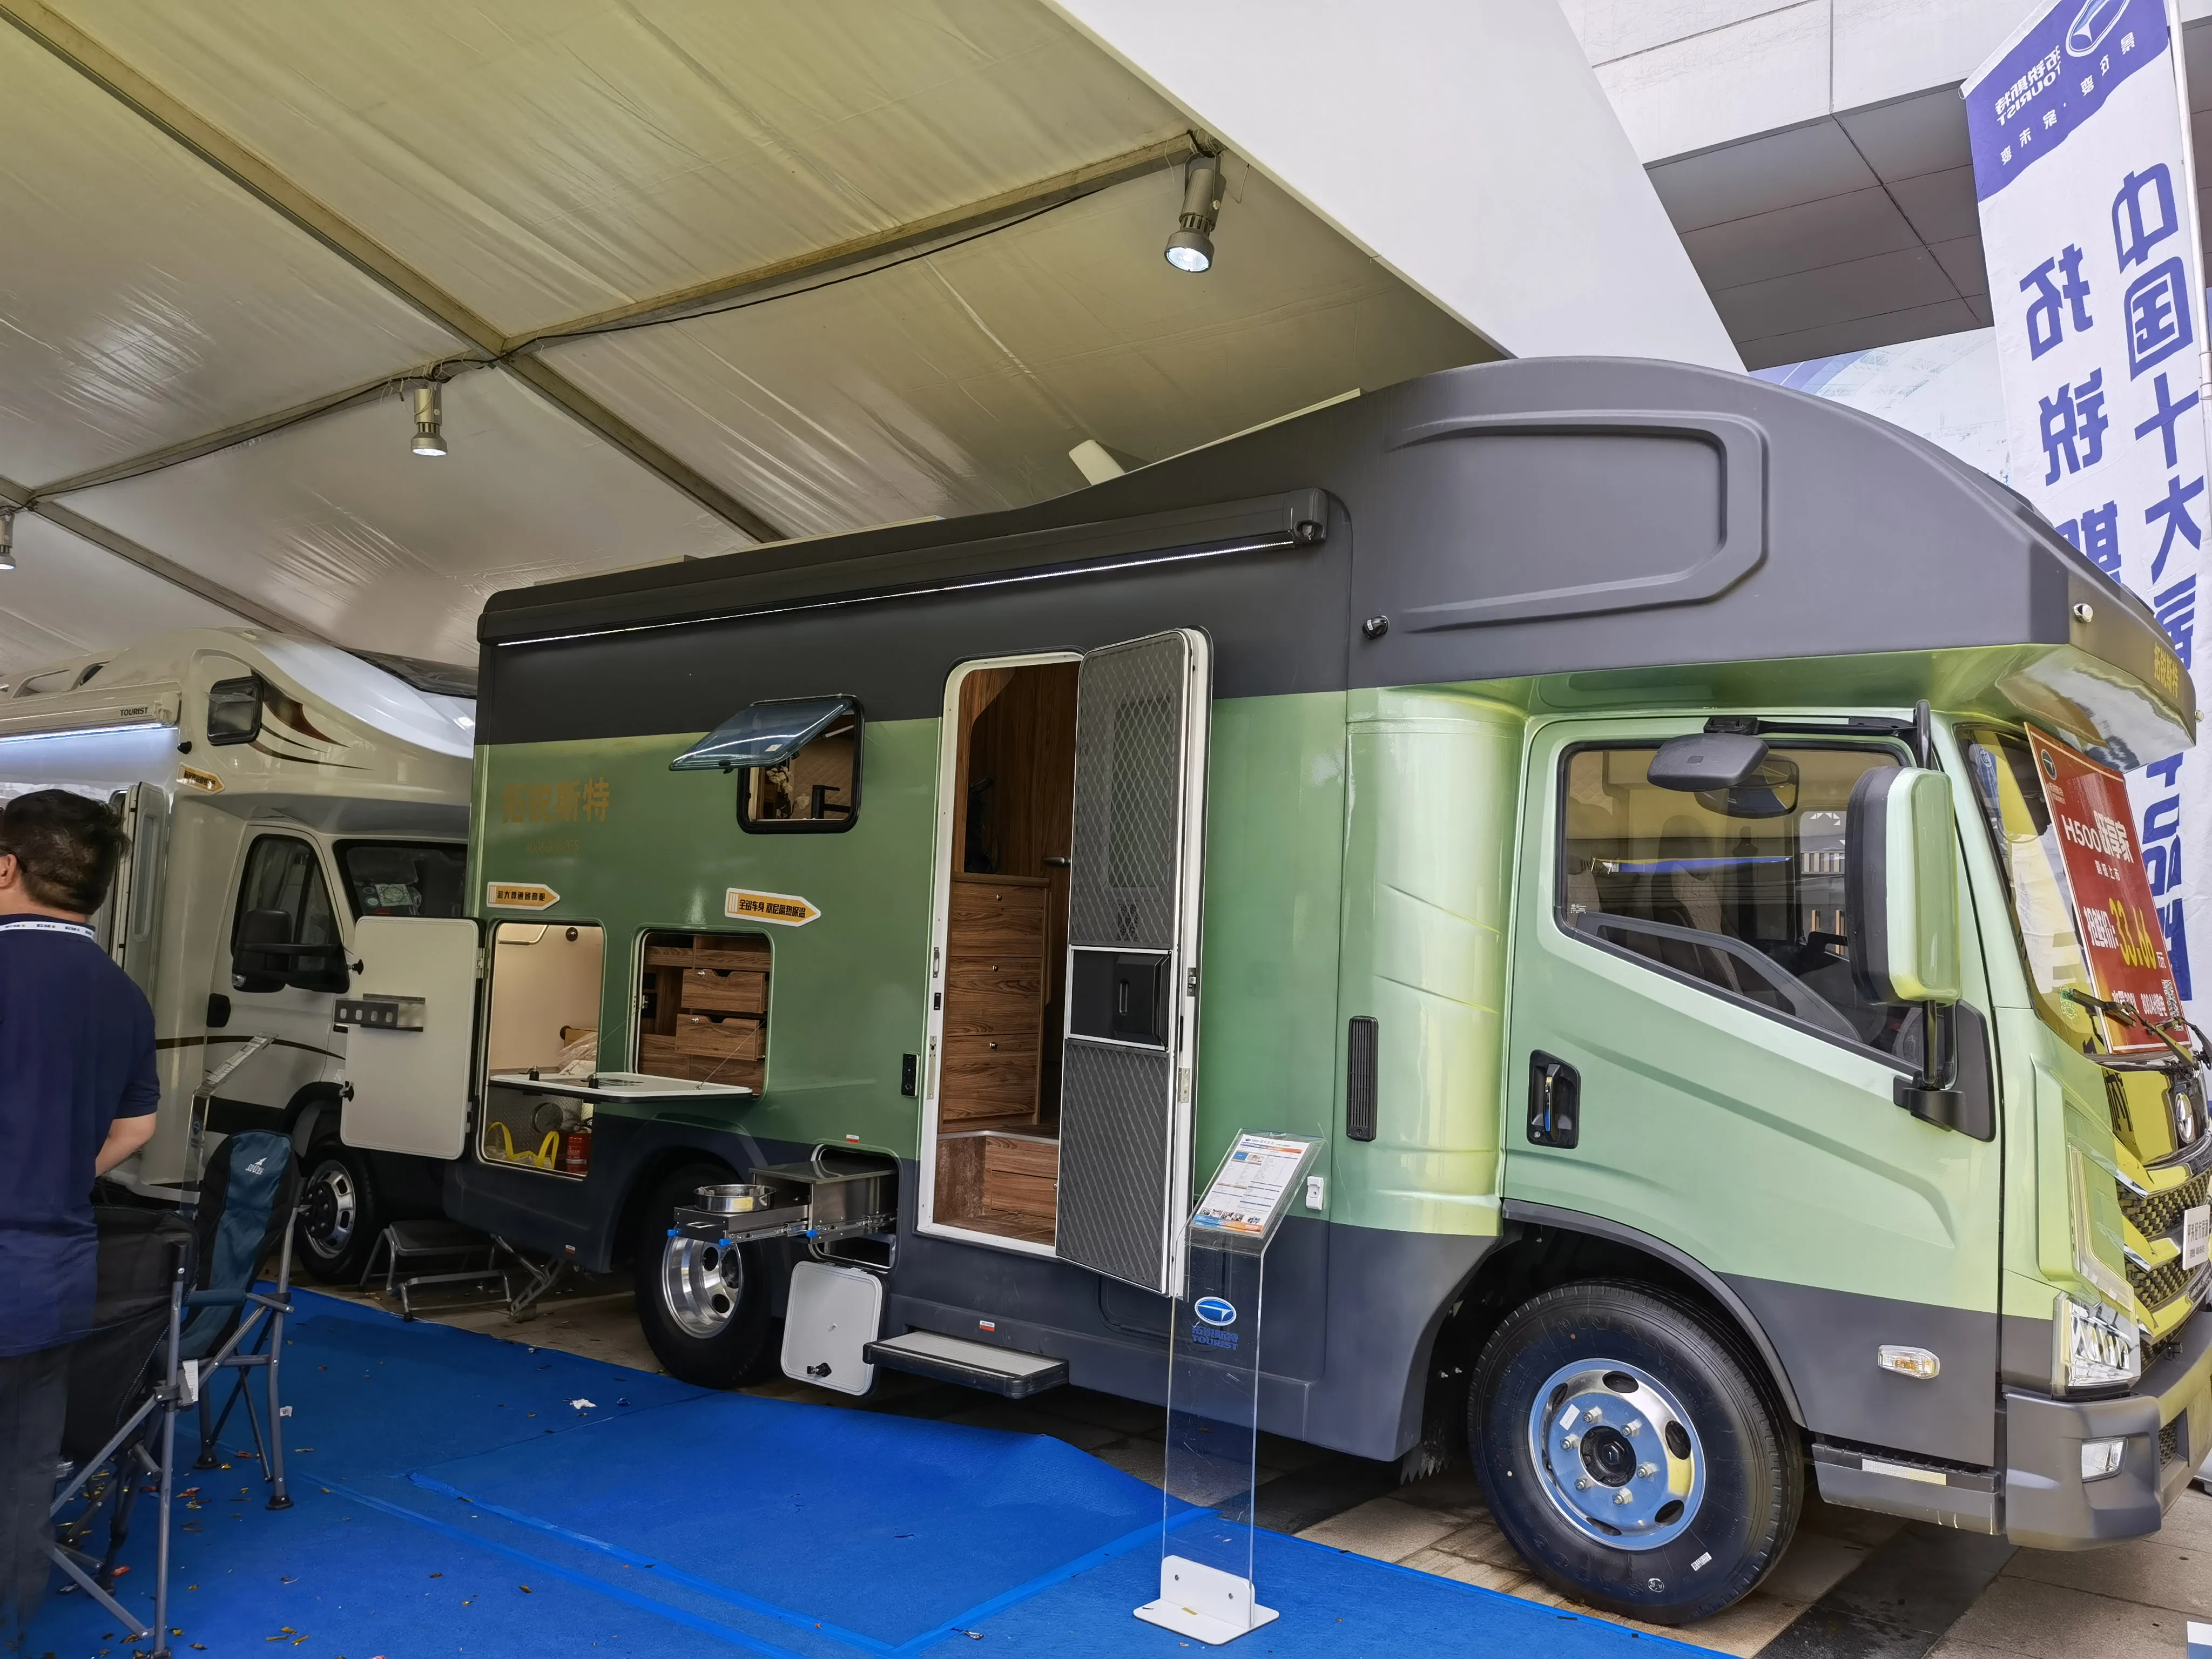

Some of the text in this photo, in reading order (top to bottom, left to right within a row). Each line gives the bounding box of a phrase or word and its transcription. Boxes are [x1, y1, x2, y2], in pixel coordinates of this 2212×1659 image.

[120, 706, 149, 717] TOURIST
[502, 777, 610, 824] 拓锐斯特
[1191, 1334, 1239, 1351] TOURIST
